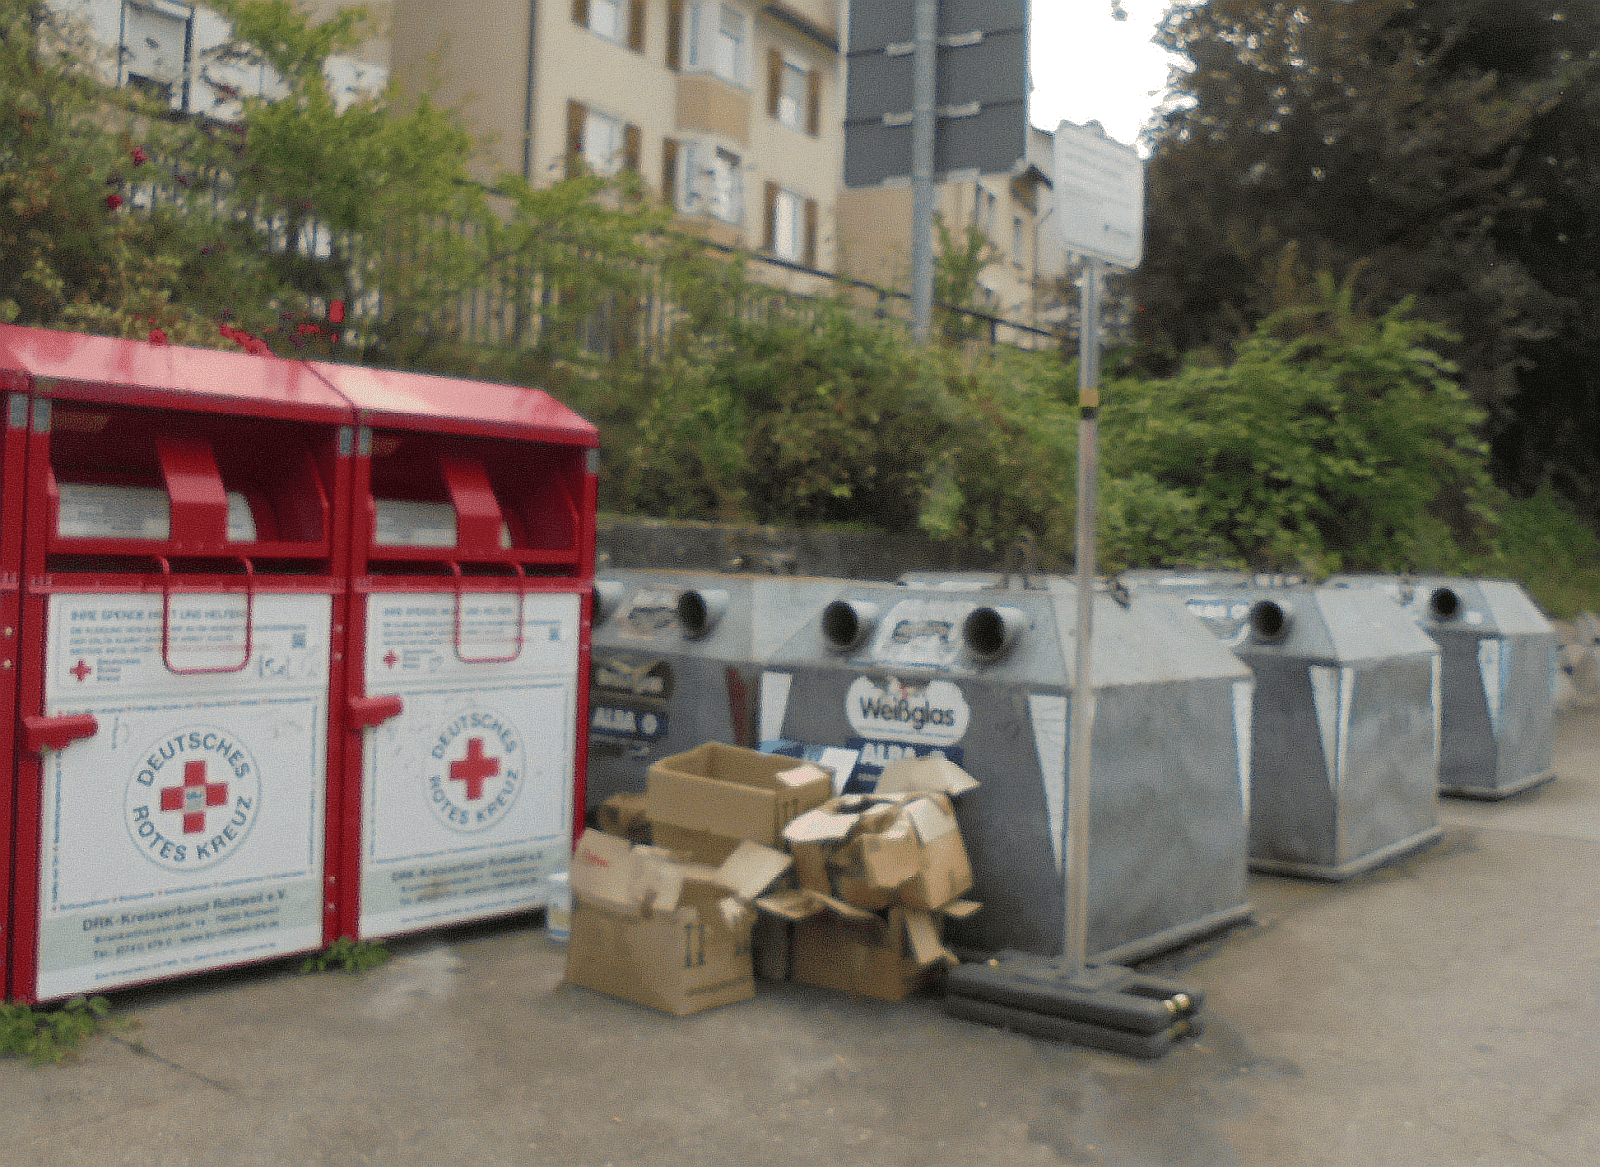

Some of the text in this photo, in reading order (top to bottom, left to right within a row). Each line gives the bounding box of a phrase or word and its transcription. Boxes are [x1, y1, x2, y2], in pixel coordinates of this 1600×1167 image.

[592, 706, 637, 732] ALBA
[858, 697, 956, 730] Weißglas
[137, 731, 251, 788] DEUTSCHES
[133, 804, 187, 862] ROTES
[196, 795, 253, 860] KREUZ
